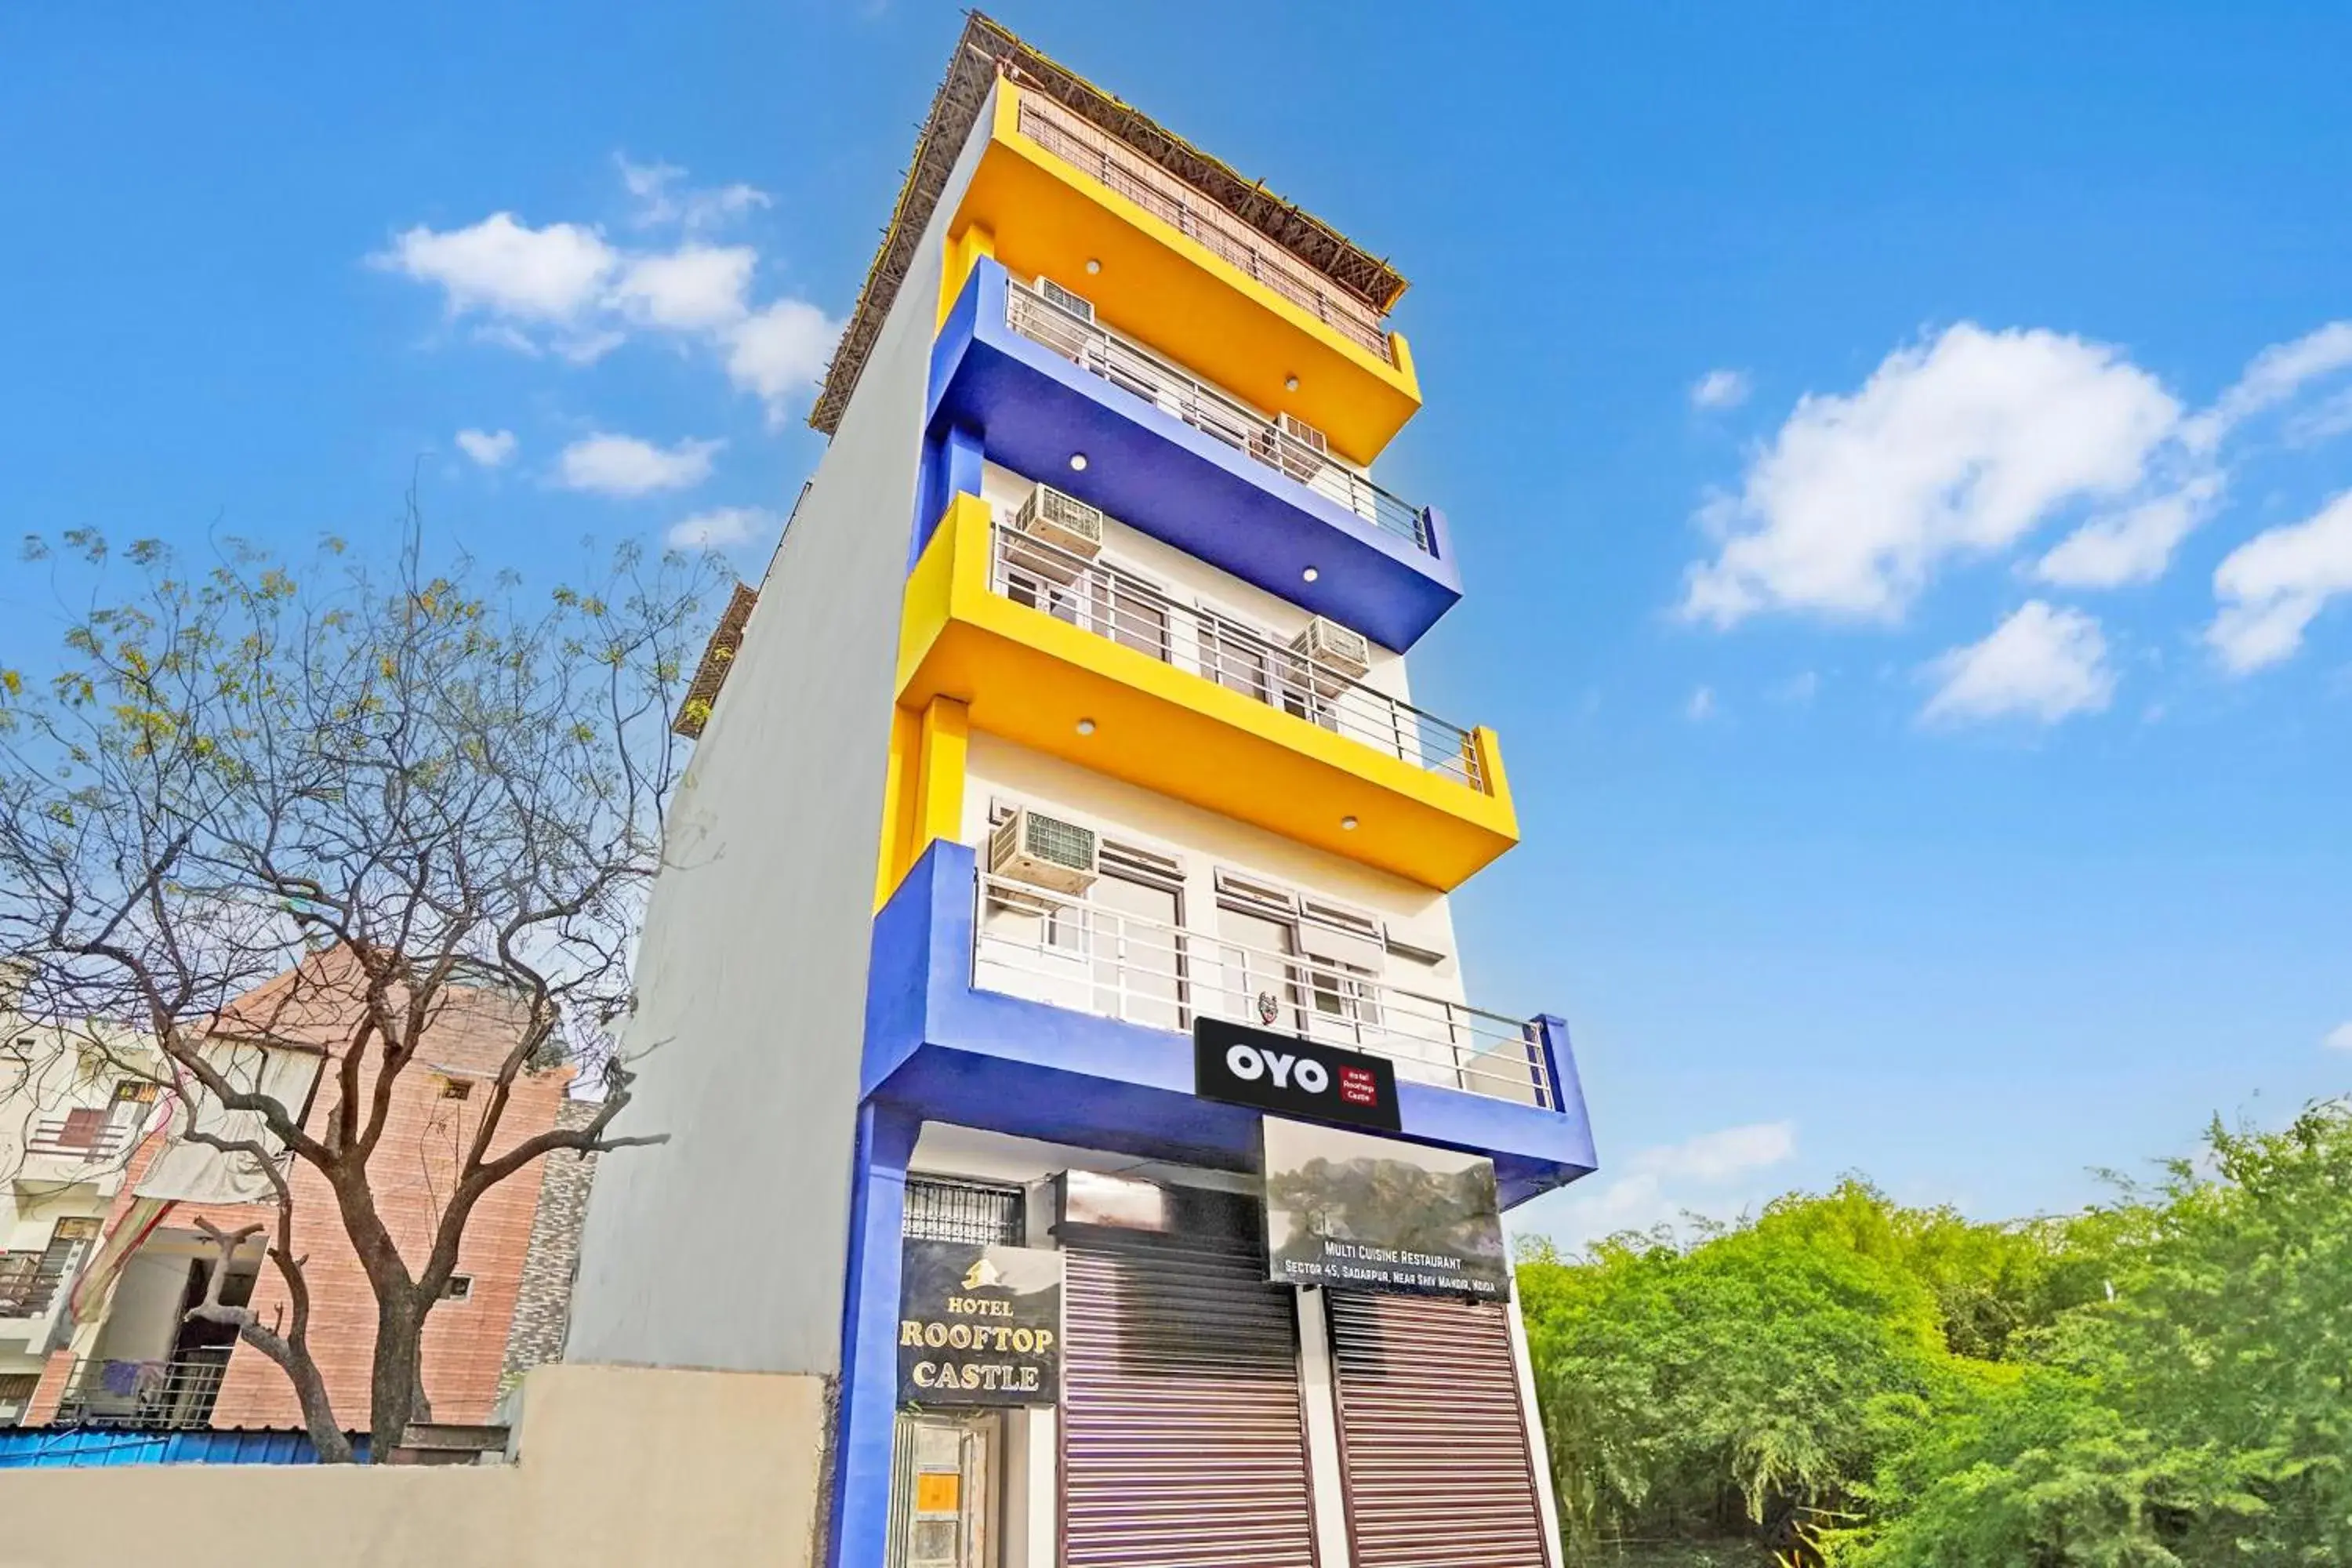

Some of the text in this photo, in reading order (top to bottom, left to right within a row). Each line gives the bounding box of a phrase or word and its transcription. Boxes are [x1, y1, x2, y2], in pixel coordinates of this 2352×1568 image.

[1226, 1044, 1329, 1094] OYO
[1324, 1241, 1356, 1258] MULTI
[1359, 1245, 1398, 1263] CUISINE
[1285, 1259, 1322, 1275] SECTOR
[1325, 1264, 1340, 1278] 45,
[947, 1297, 1014, 1317] HOTEL
[899, 1319, 1054, 1354] ROOFTOP
[912, 1360, 1040, 1392] CASTLE
